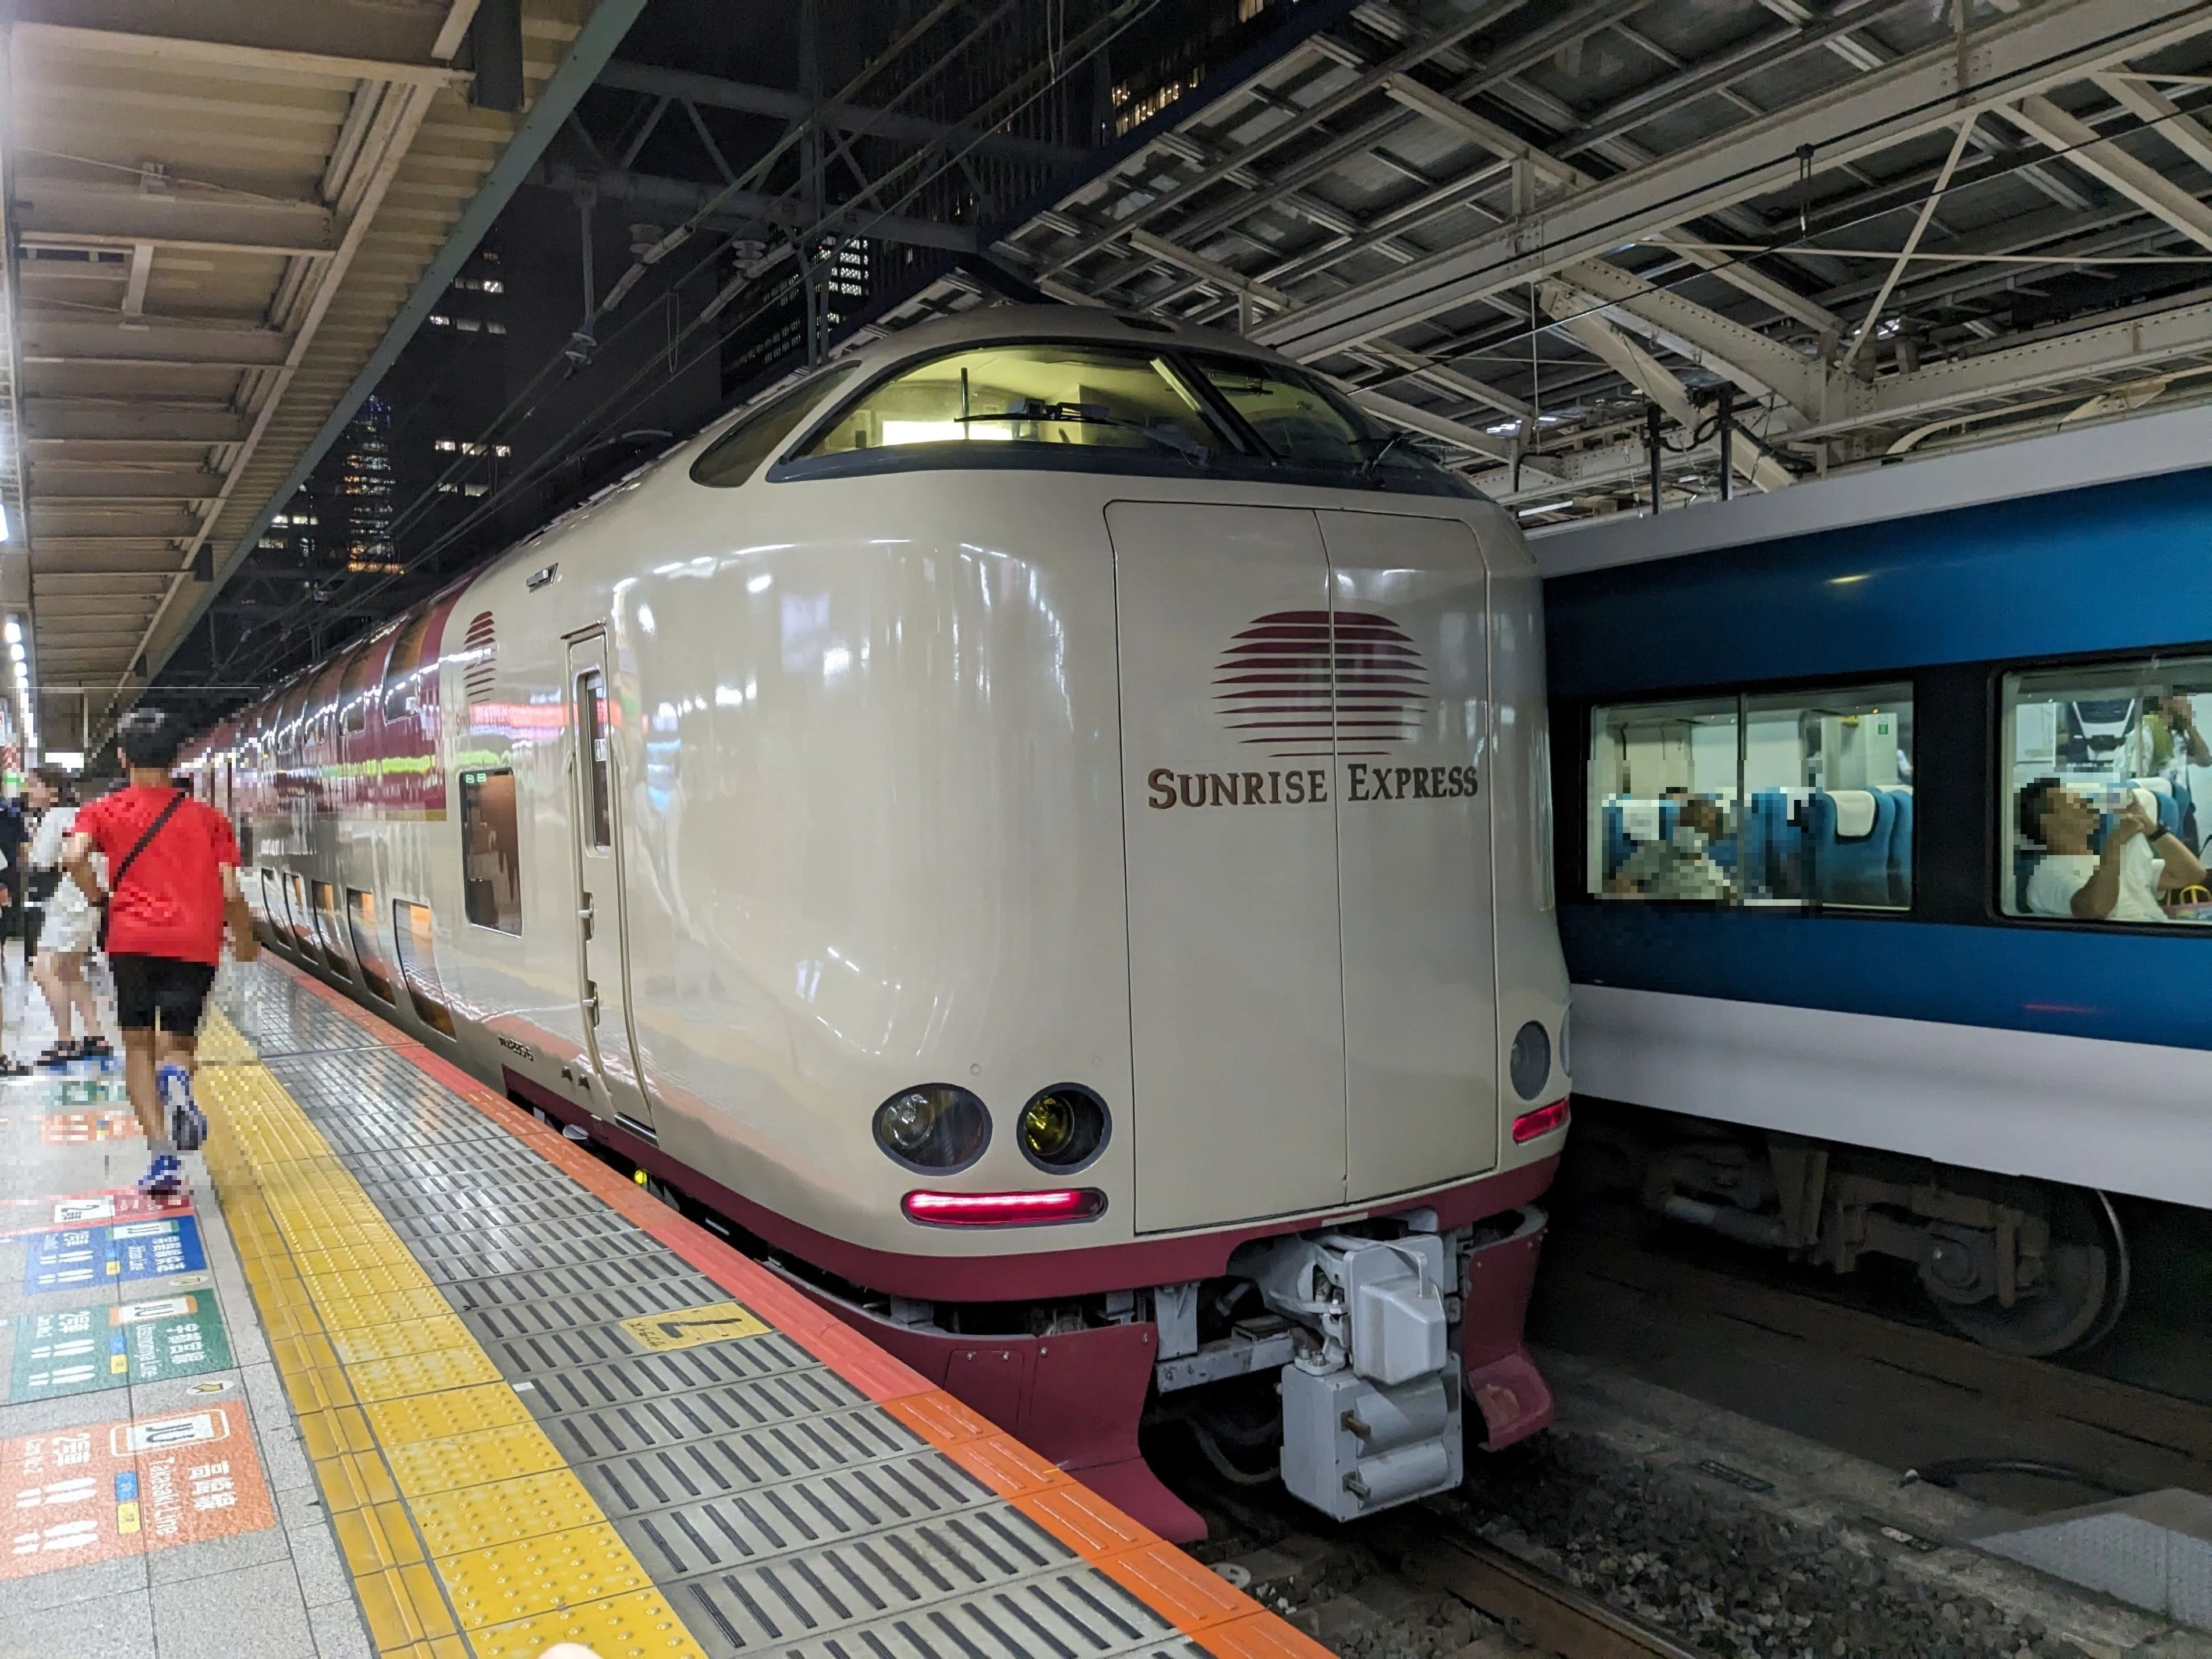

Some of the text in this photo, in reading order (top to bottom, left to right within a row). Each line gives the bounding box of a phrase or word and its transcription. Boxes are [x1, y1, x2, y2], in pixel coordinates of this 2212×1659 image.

[1148, 763, 1477, 809] SUNRISE EXPRESS
[59, 1311, 91, 1334] 2号車
[134, 1304, 173, 1317] JU
[657, 1318, 743, 1338] 7
[166, 1323, 207, 1364] 宇都宮線
[140, 1360, 162, 1377] Line
[145, 1423, 195, 1442] JU
[52, 1433, 91, 1467] 2号車
[148, 1456, 183, 1536] Takasaki Line
[188, 1460, 238, 1511] 高崎線
